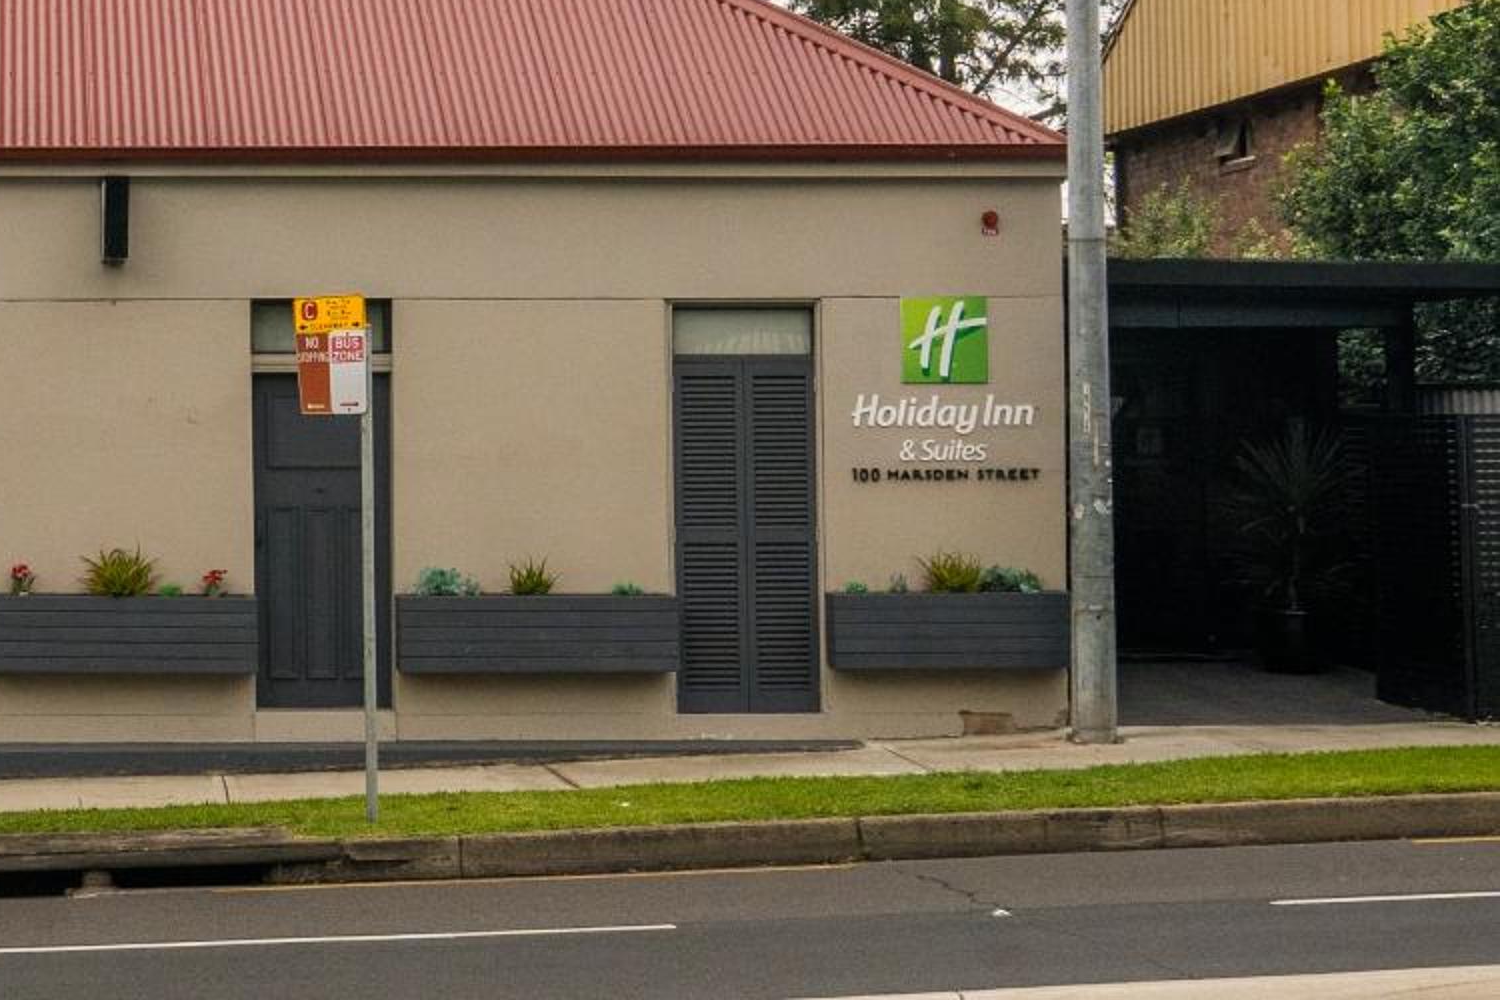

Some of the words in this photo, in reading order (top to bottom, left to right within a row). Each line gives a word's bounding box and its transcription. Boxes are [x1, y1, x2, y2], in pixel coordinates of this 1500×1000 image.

[305, 337, 319, 349] NO
[335, 336, 360, 349] BUS
[332, 350, 364, 361] ZONE
[852, 394, 979, 434] Holiday
[983, 394, 1035, 427] Inn
[900, 439, 916, 461] &
[921, 439, 988, 461] Suites
[852, 467, 881, 482] 100
[887, 468, 969, 481] MARSDEN
[977, 467, 1042, 481] STREET
